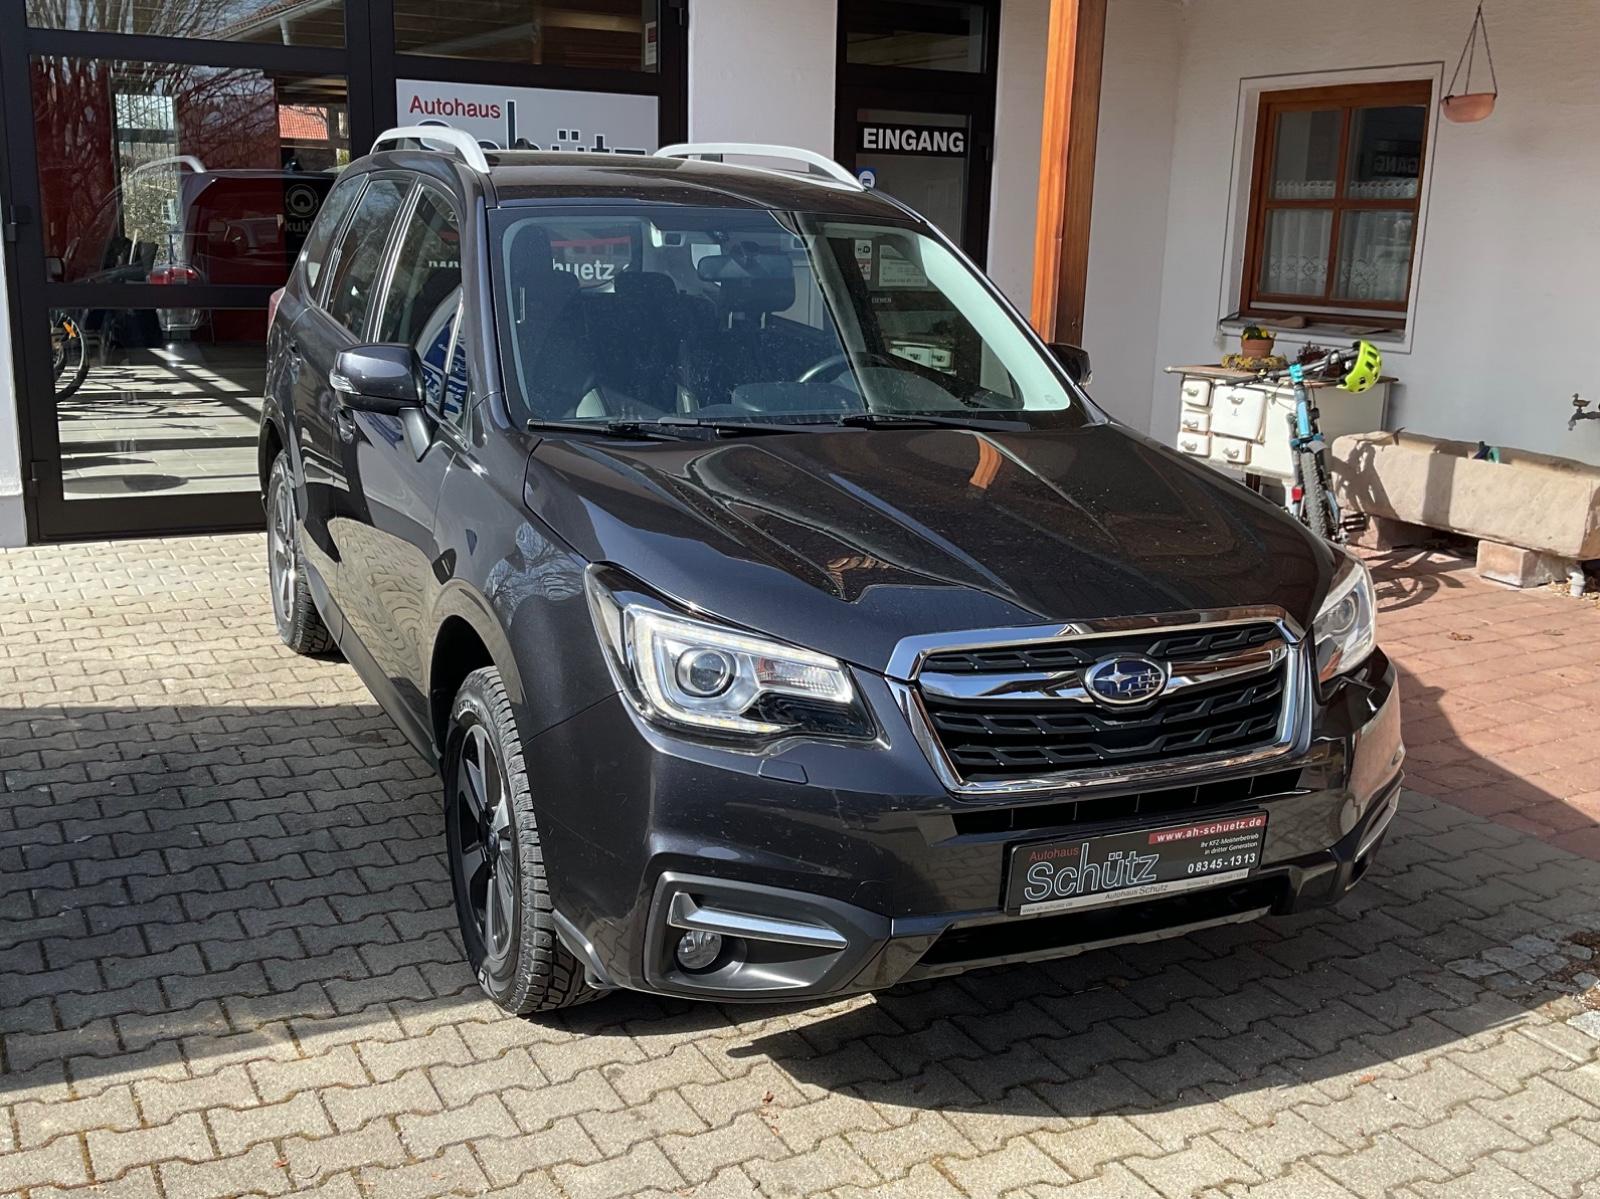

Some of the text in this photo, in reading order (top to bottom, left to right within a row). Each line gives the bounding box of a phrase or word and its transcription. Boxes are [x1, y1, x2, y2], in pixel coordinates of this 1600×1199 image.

[409, 95, 501, 119] Autohaus
[863, 127, 965, 153] EINGANG
[1156, 818, 1263, 843] www.ah-schuetz.de
[1029, 847, 1079, 862] Autohaus
[1024, 843, 1160, 902] Schütz
